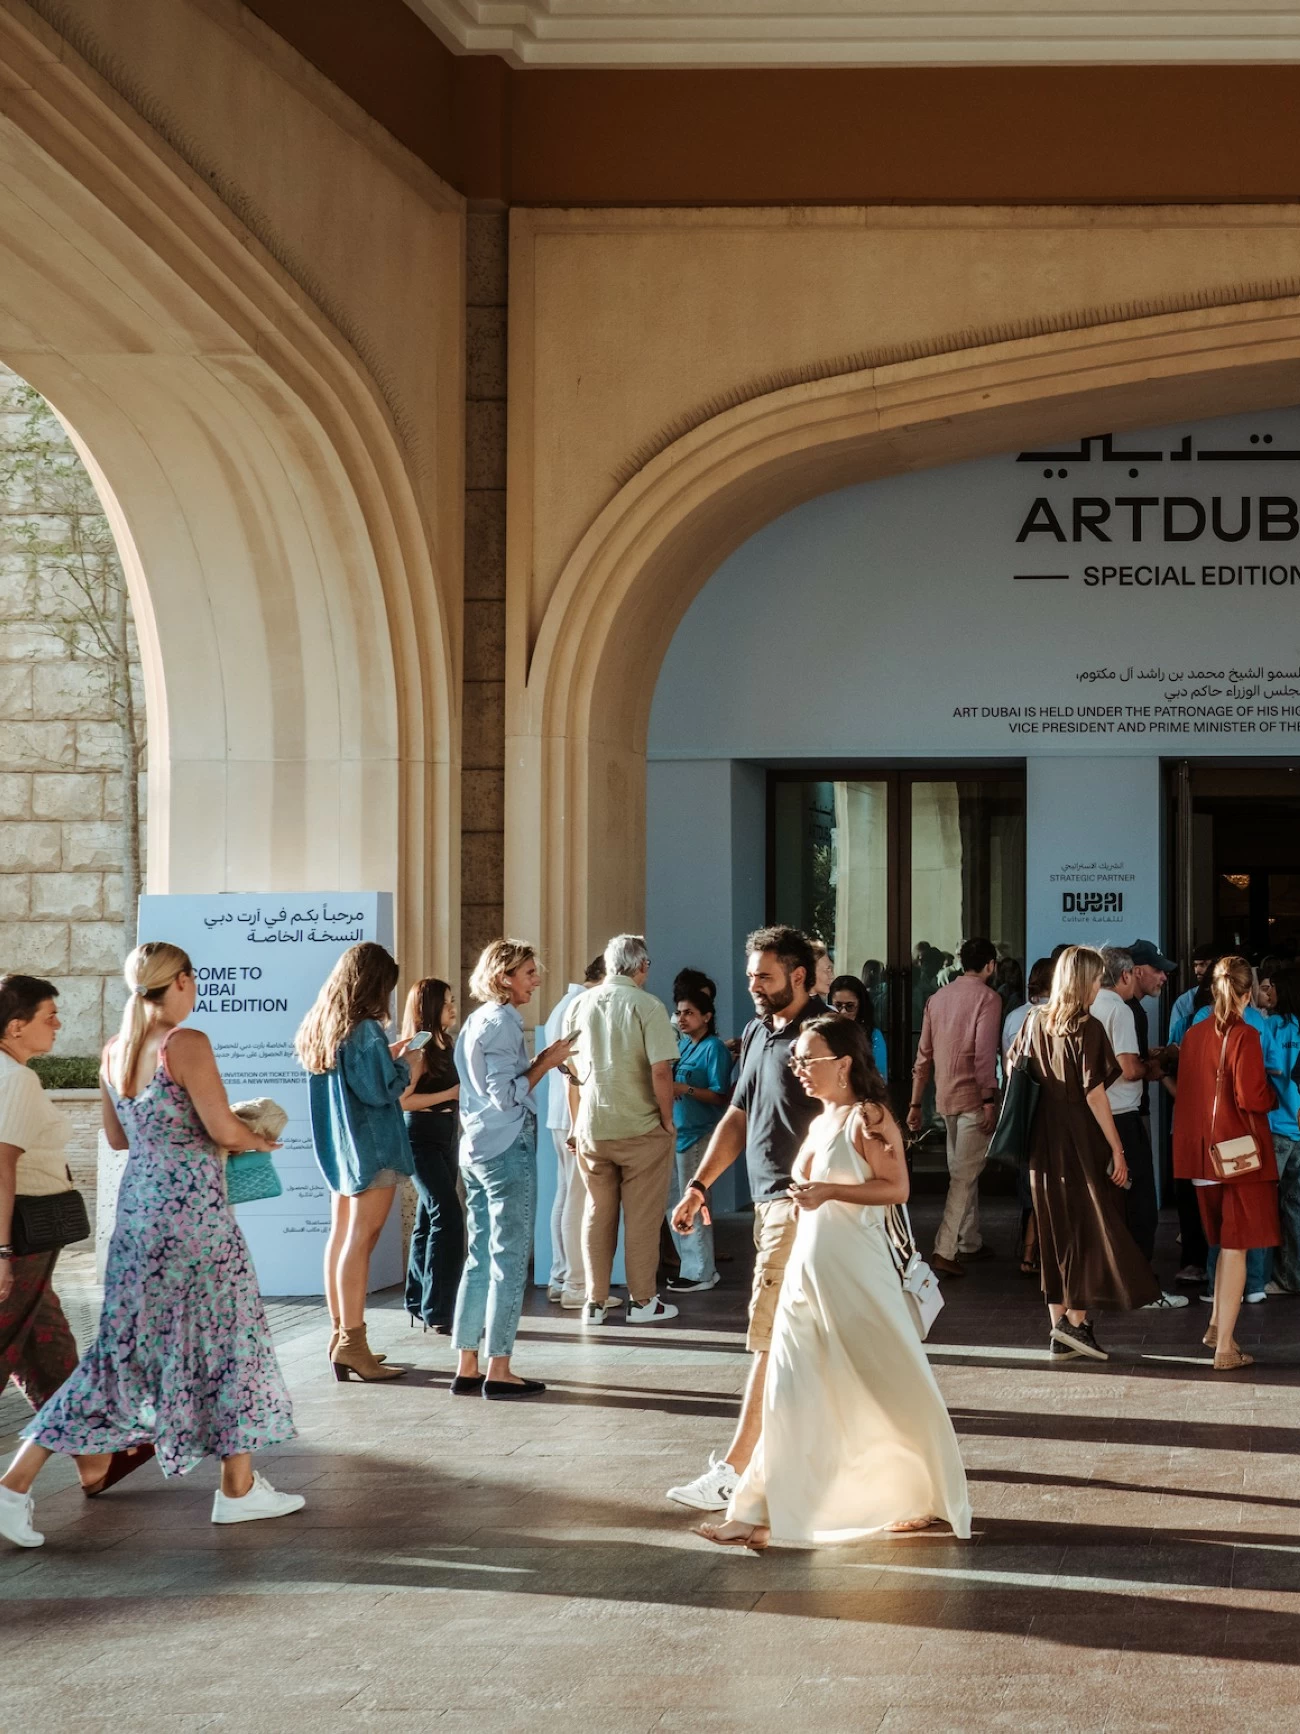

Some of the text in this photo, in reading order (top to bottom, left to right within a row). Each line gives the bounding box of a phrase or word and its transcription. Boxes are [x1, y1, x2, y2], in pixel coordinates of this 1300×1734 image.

[1083, 566, 1196, 587] SPECIAL
[1137, 667, 1165, 682] راشد
[1169, 671, 1184, 682] بن
[1187, 670, 1225, 679] محمد
[1228, 667, 1264, 682] الشيخ
[1164, 688, 1188, 702] دبي
[1191, 685, 1222, 700] حاكم
[1226, 685, 1260, 700] الوزراء
[953, 707, 978, 718] ART
[981, 707, 1021, 718] DUBAI
[1024, 707, 1036, 718] IS
[1040, 707, 1074, 718] HELD
[1077, 706, 1123, 717] UNDER
[1125, 706, 1150, 717] THE
[1154, 706, 1233, 717] PATRONAGE
[1236, 706, 1253, 717] OF
[1257, 706, 1278, 717] HIS
[1009, 722, 1039, 733] VICE
[1042, 722, 1115, 733] PRESIDENT
[1117, 722, 1146, 733] AND
[1149, 721, 1190, 732] PRIME
[1193, 721, 1256, 732] MINISTER
[1259, 721, 1277, 732] OF
[1049, 874, 1095, 882] STRATEGIC
[1062, 892, 1123, 915] DUBAI
[204, 911, 233, 929] دبي
[264, 907, 287, 929] في
[290, 909, 319, 925] بكم
[247, 929, 364, 942] النسخة الخاصة
[239, 966, 262, 980] TO
[197, 983, 236, 997] UBAI
[221, 998, 288, 1012] EDITION
